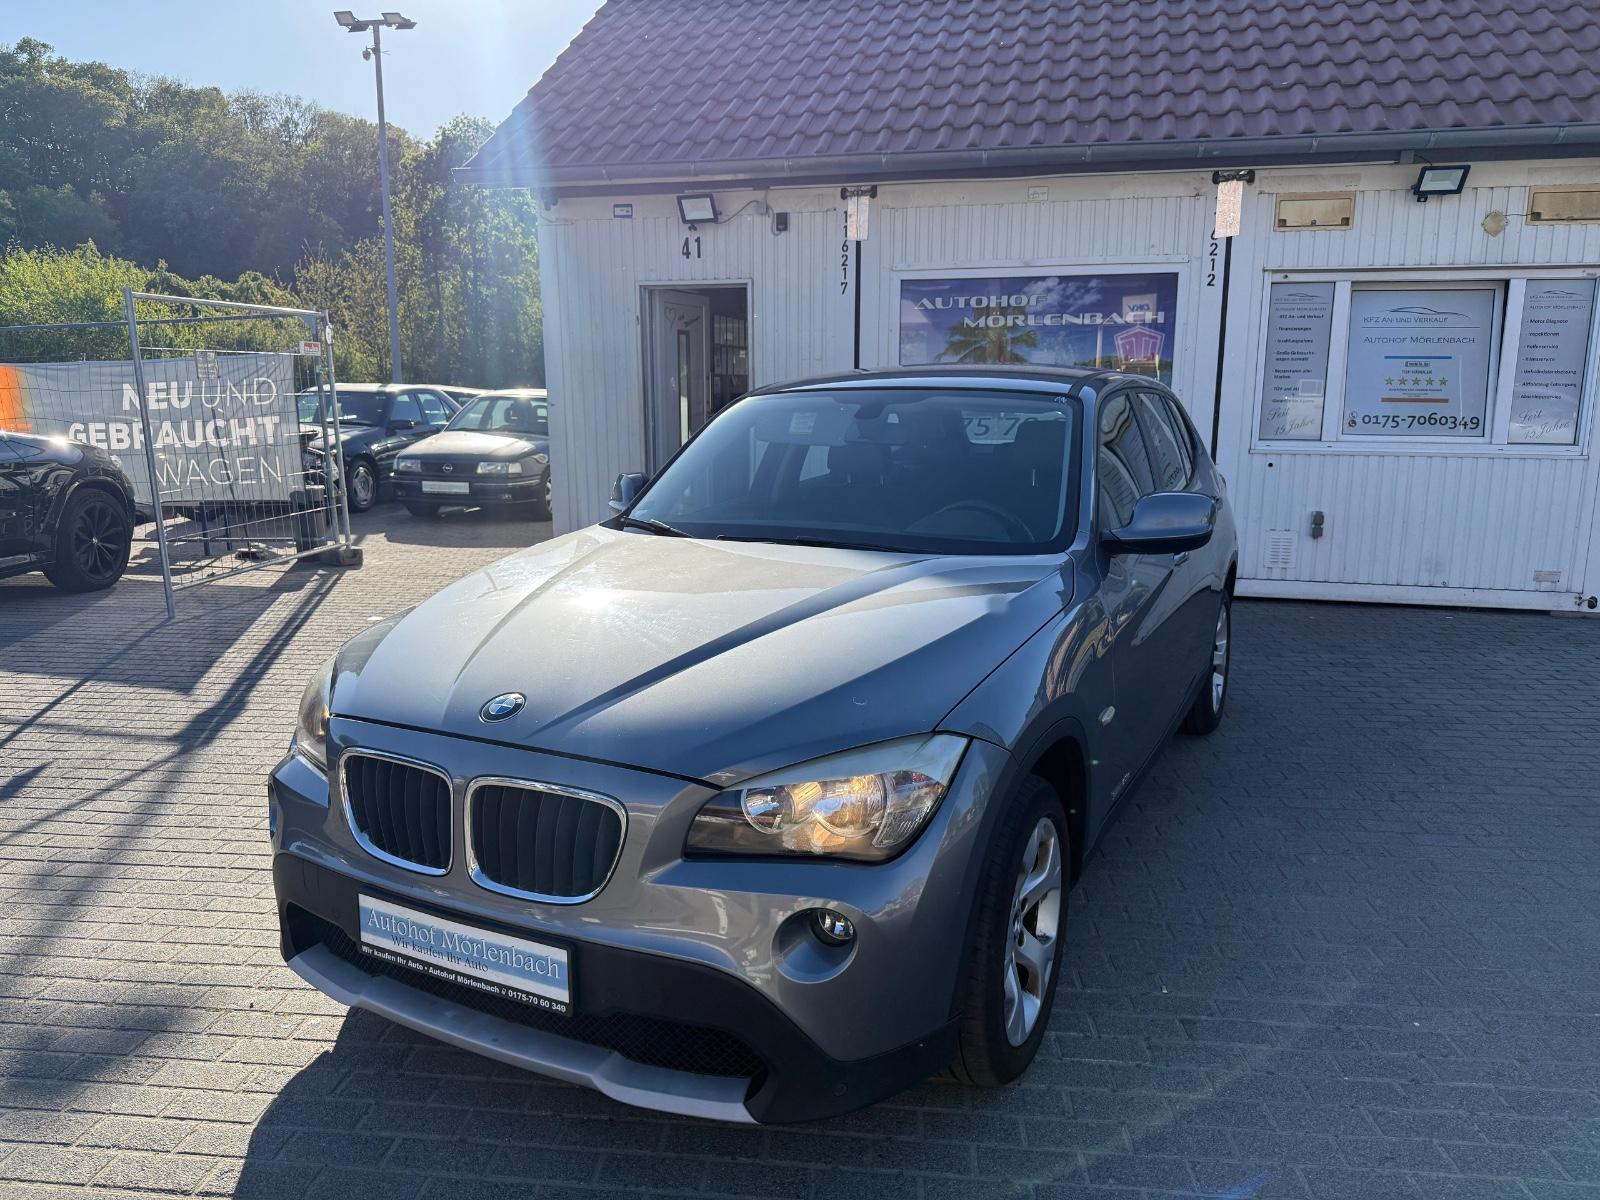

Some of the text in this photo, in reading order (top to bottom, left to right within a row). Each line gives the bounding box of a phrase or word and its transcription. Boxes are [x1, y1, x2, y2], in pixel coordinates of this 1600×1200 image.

[682, 236, 701, 260] 41
[914, 295, 1049, 310] AUTOHOF
[963, 311, 1165, 328] MÖRLENBACH
[1363, 335, 1476, 344] AUTOHOF MÖRLENBACH
[122, 377, 277, 411] NEU UND
[69, 415, 280, 450] GEBRAUCHT
[1361, 412, 1480, 430] 0175-7060349
[155, 456, 282, 486] WAGEN
[368, 907, 560, 979] Autohof Mörlenbach
[391, 934, 489, 972] Wir kaufen Ihr Auto
[361, 945, 566, 1013] Wir kaufen Ihr Auto Autohof Mörlenbach 0175-70 60 349
